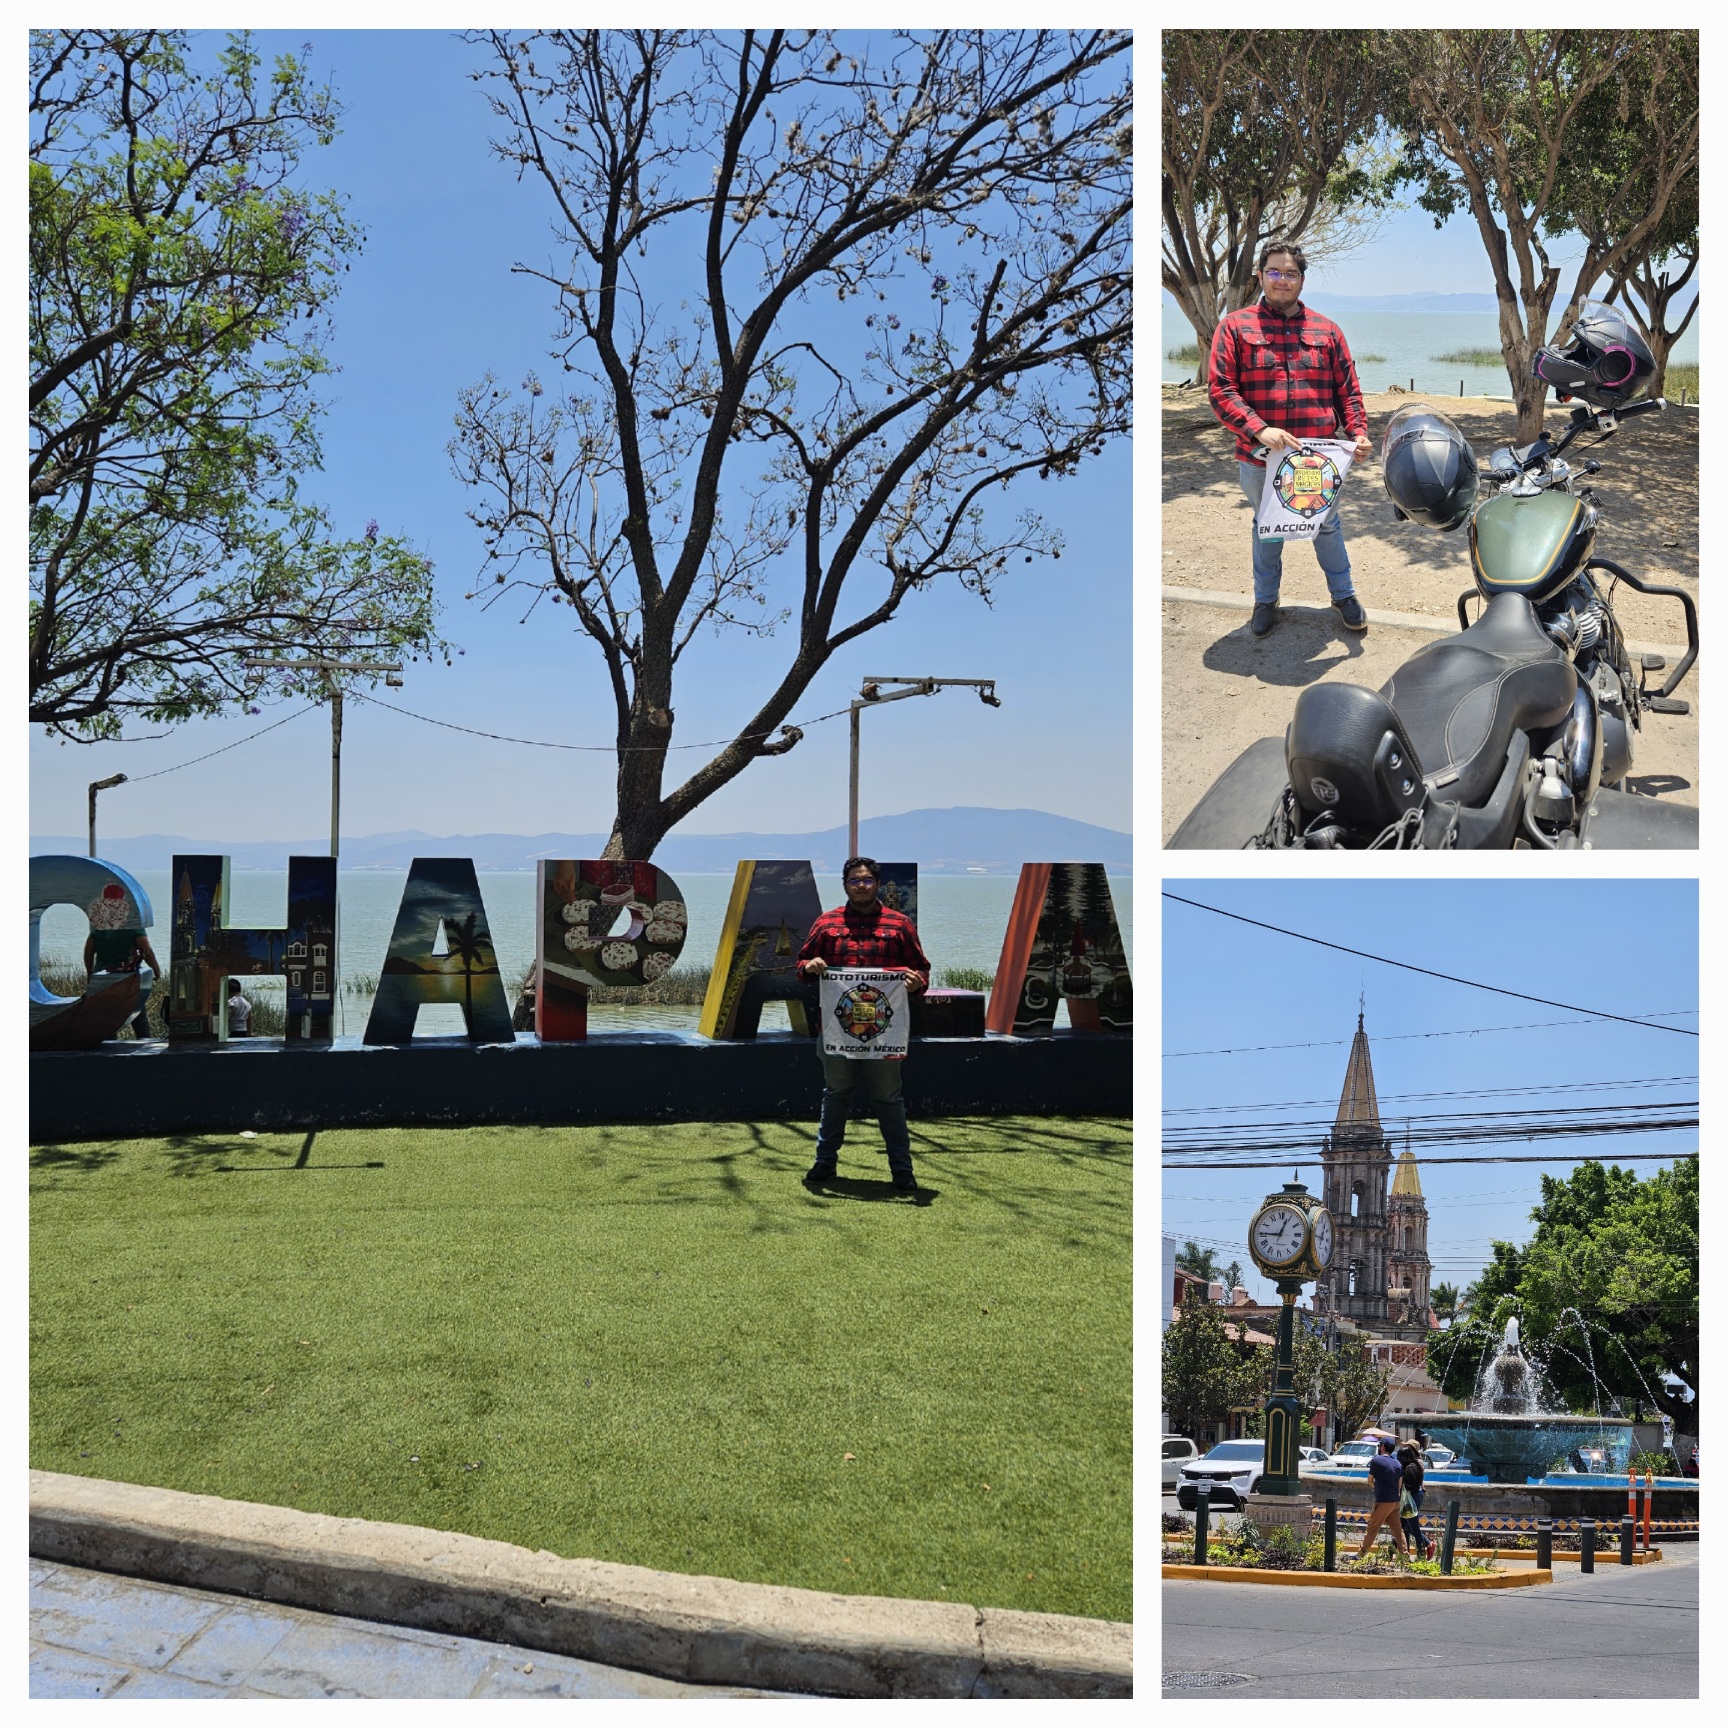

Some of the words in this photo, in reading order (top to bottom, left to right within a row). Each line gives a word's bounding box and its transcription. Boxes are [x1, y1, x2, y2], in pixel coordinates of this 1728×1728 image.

[1274, 521, 1315, 533] ACCIÓN
[821, 973, 906, 982] MOTOTURISMO
[839, 1043, 870, 1052] ACCIÓN
[874, 1043, 906, 1053] MÉXICO
